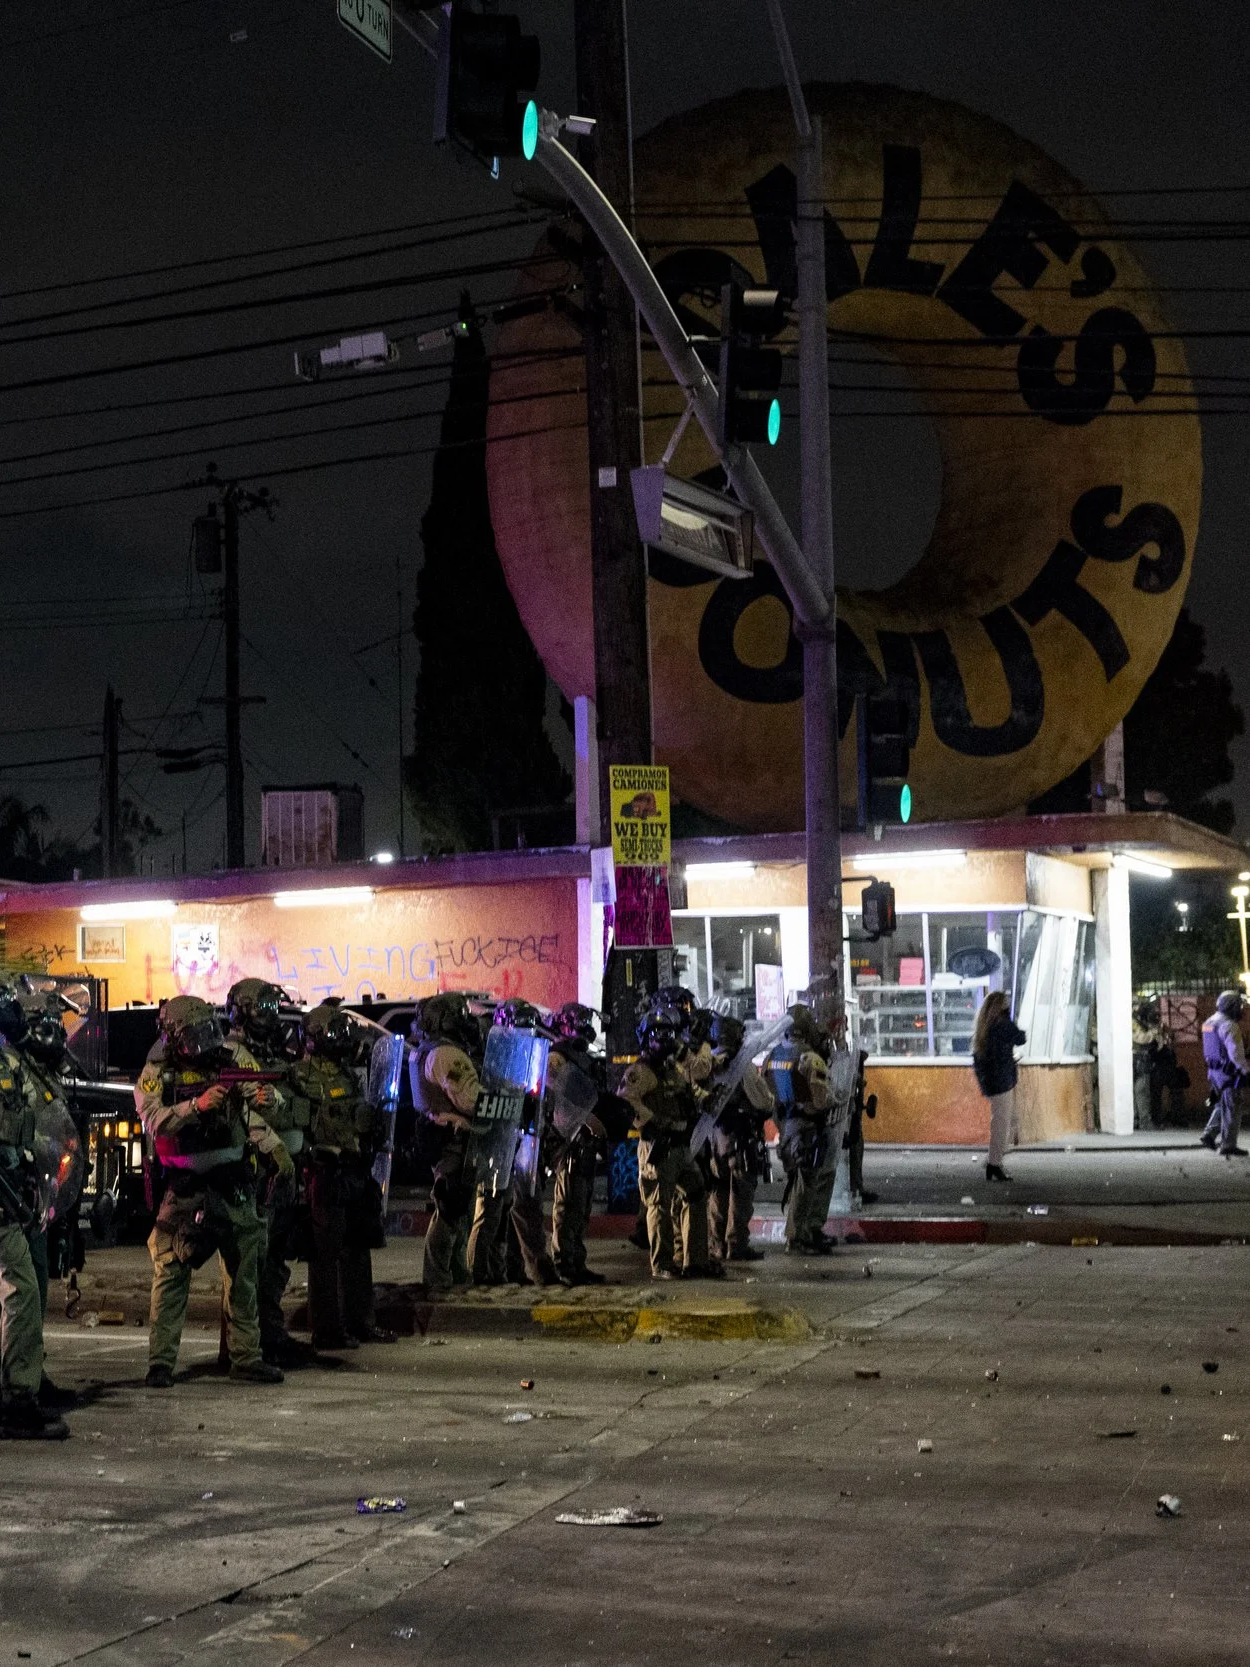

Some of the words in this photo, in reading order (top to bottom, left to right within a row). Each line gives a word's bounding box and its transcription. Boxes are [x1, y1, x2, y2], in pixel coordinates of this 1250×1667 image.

[367, 3, 389, 40] TURN
[612, 768, 667, 778] COMPRAMOS
[613, 780, 667, 790] CAMIONES
[614, 822, 638, 837] WE
[641, 822, 667, 837] BUY
[271, 943, 435, 982] LIVING
